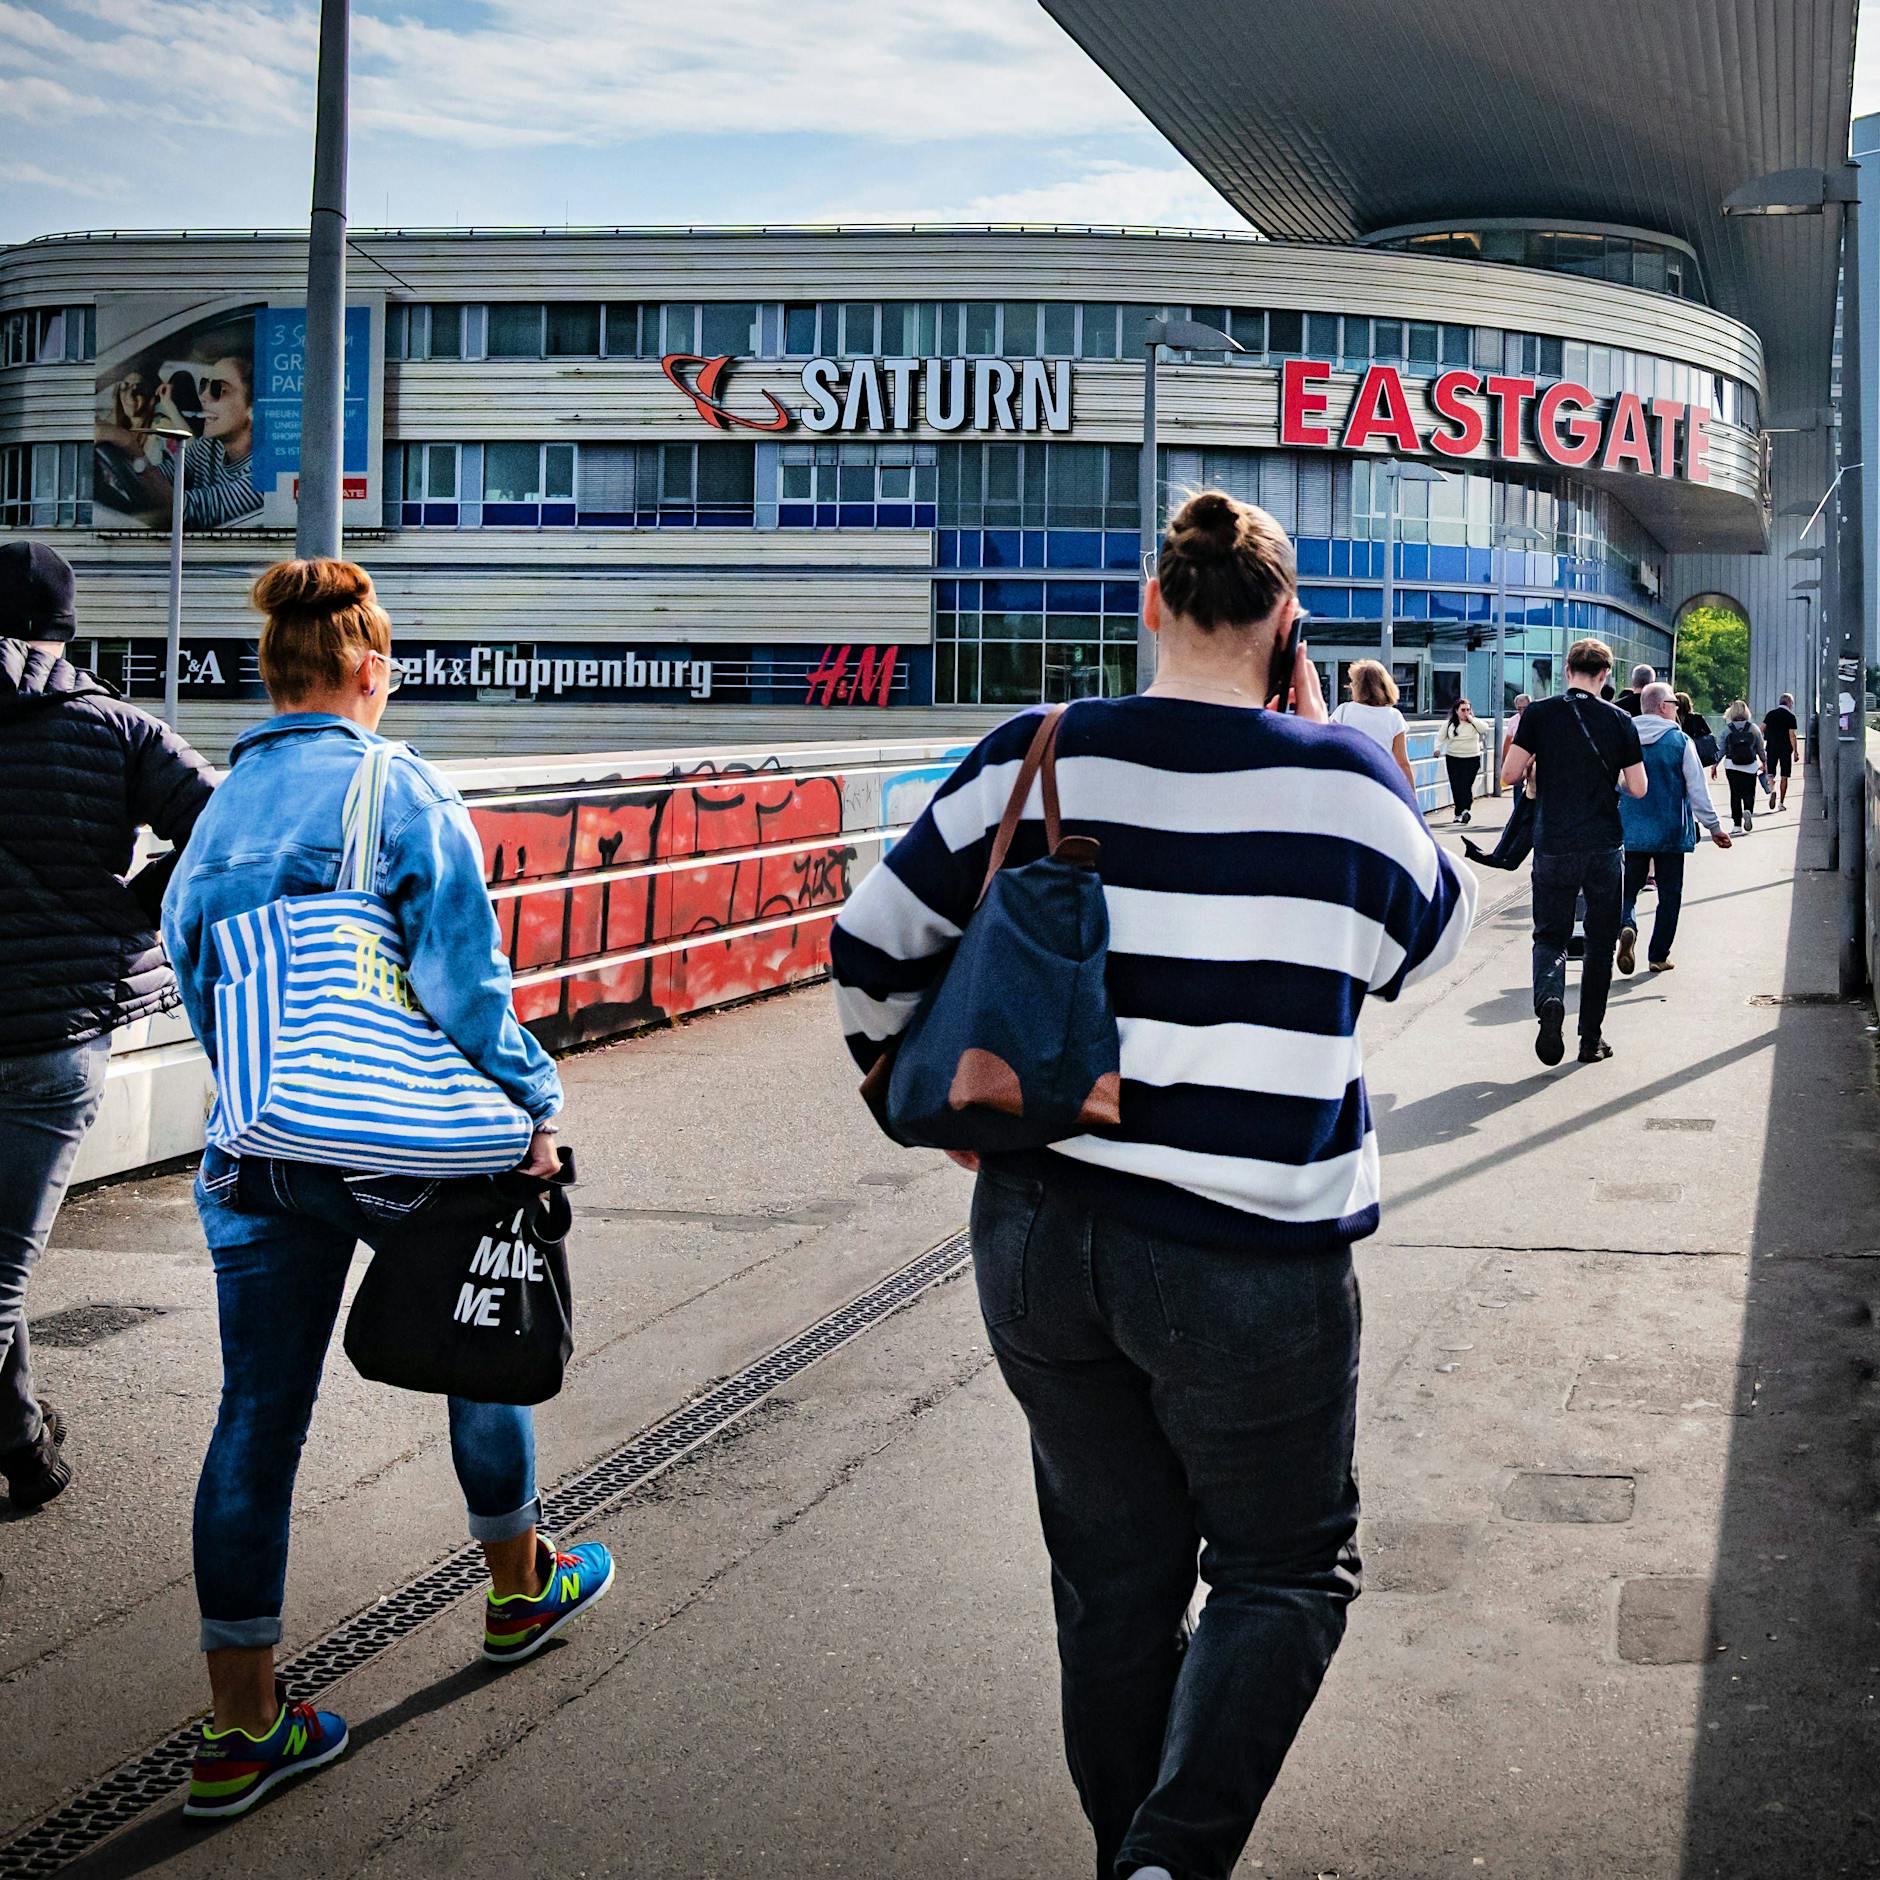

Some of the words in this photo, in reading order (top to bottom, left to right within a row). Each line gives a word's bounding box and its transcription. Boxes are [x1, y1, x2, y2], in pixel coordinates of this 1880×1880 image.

[270, 324, 287, 346] 3
[801, 357, 1073, 432] SATURN
[1280, 359, 1711, 483] EASTGATE
[168, 650, 225, 684] C&A
[391, 647, 712, 698] ek&Cloppenburg
[805, 645, 898, 708] H&M
[453, 1282, 505, 1327] ME
[561, 1572, 580, 1604] N
[282, 1724, 308, 1756] N
